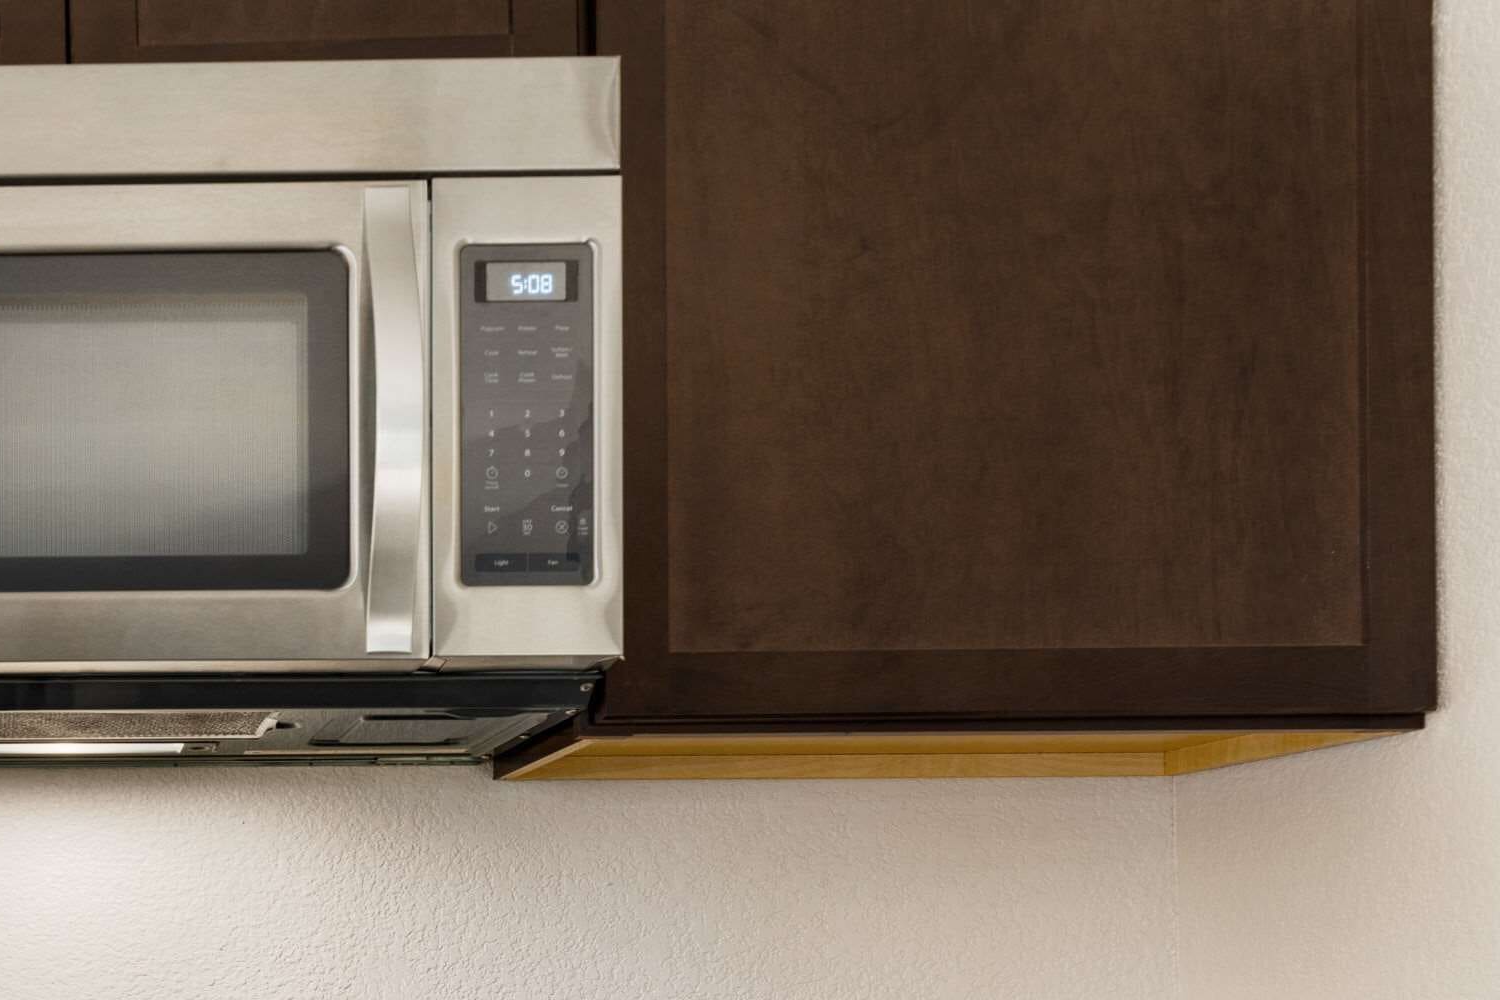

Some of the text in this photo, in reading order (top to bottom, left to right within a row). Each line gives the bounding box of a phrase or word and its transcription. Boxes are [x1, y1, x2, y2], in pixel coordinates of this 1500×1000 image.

[511, 274, 552, 294] 5:08
[524, 469, 531, 478] 0
[484, 504, 500, 512] Start
[550, 504, 573, 512] Cancel
